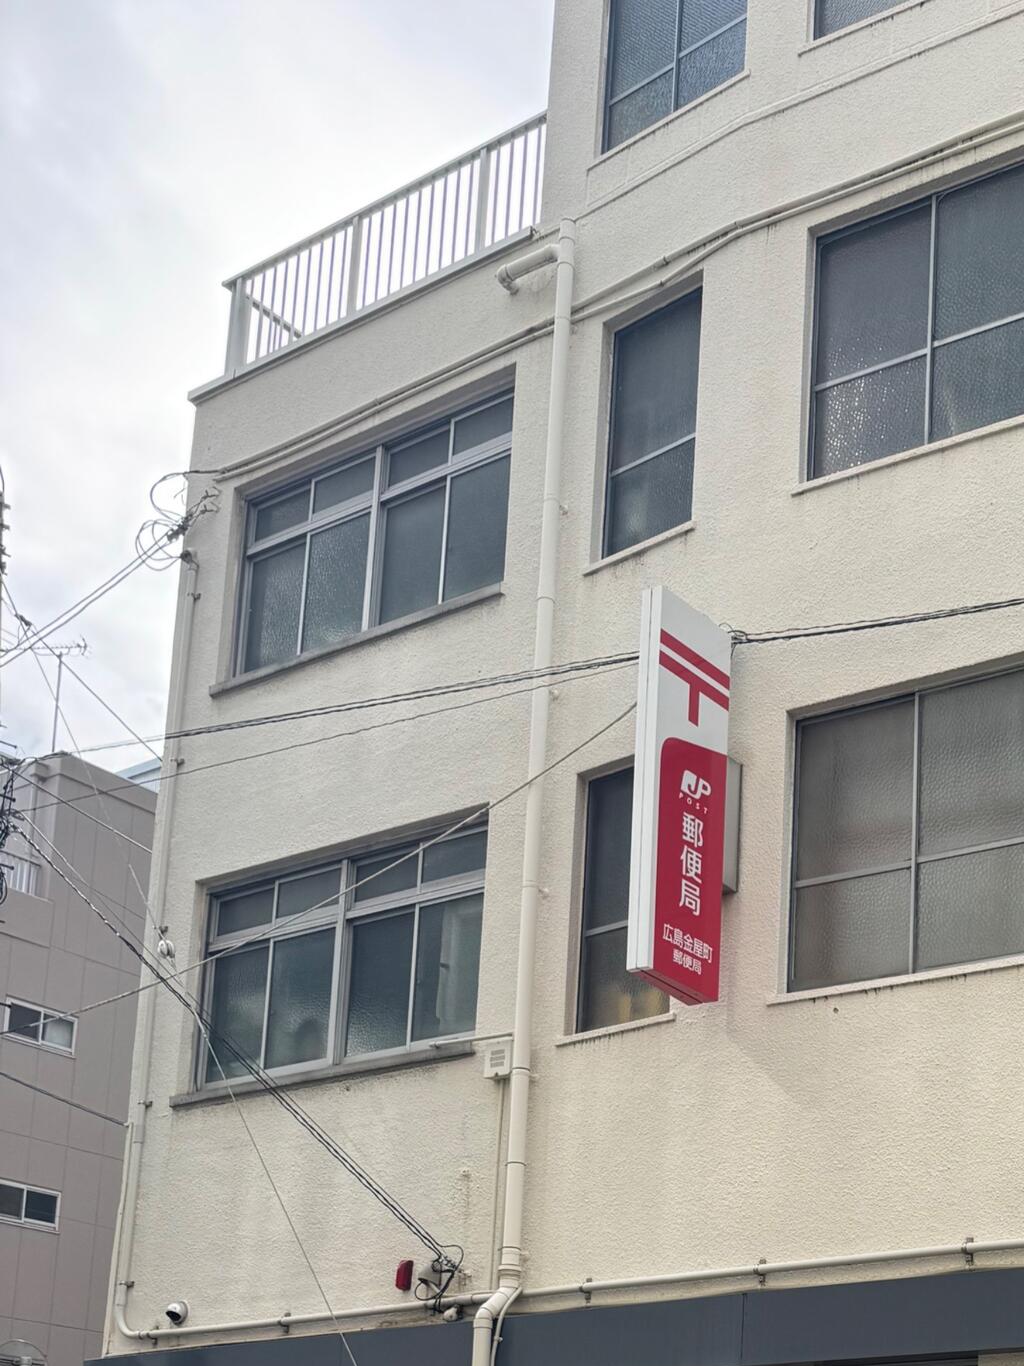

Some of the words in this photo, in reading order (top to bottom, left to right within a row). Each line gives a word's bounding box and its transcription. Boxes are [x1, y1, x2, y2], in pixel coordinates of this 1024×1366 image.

[679, 793, 708, 815] POST
[679, 811, 703, 916] 郵便局
[663, 924, 713, 963] 広島金屋町
[672, 949, 702, 975] 郵便局
